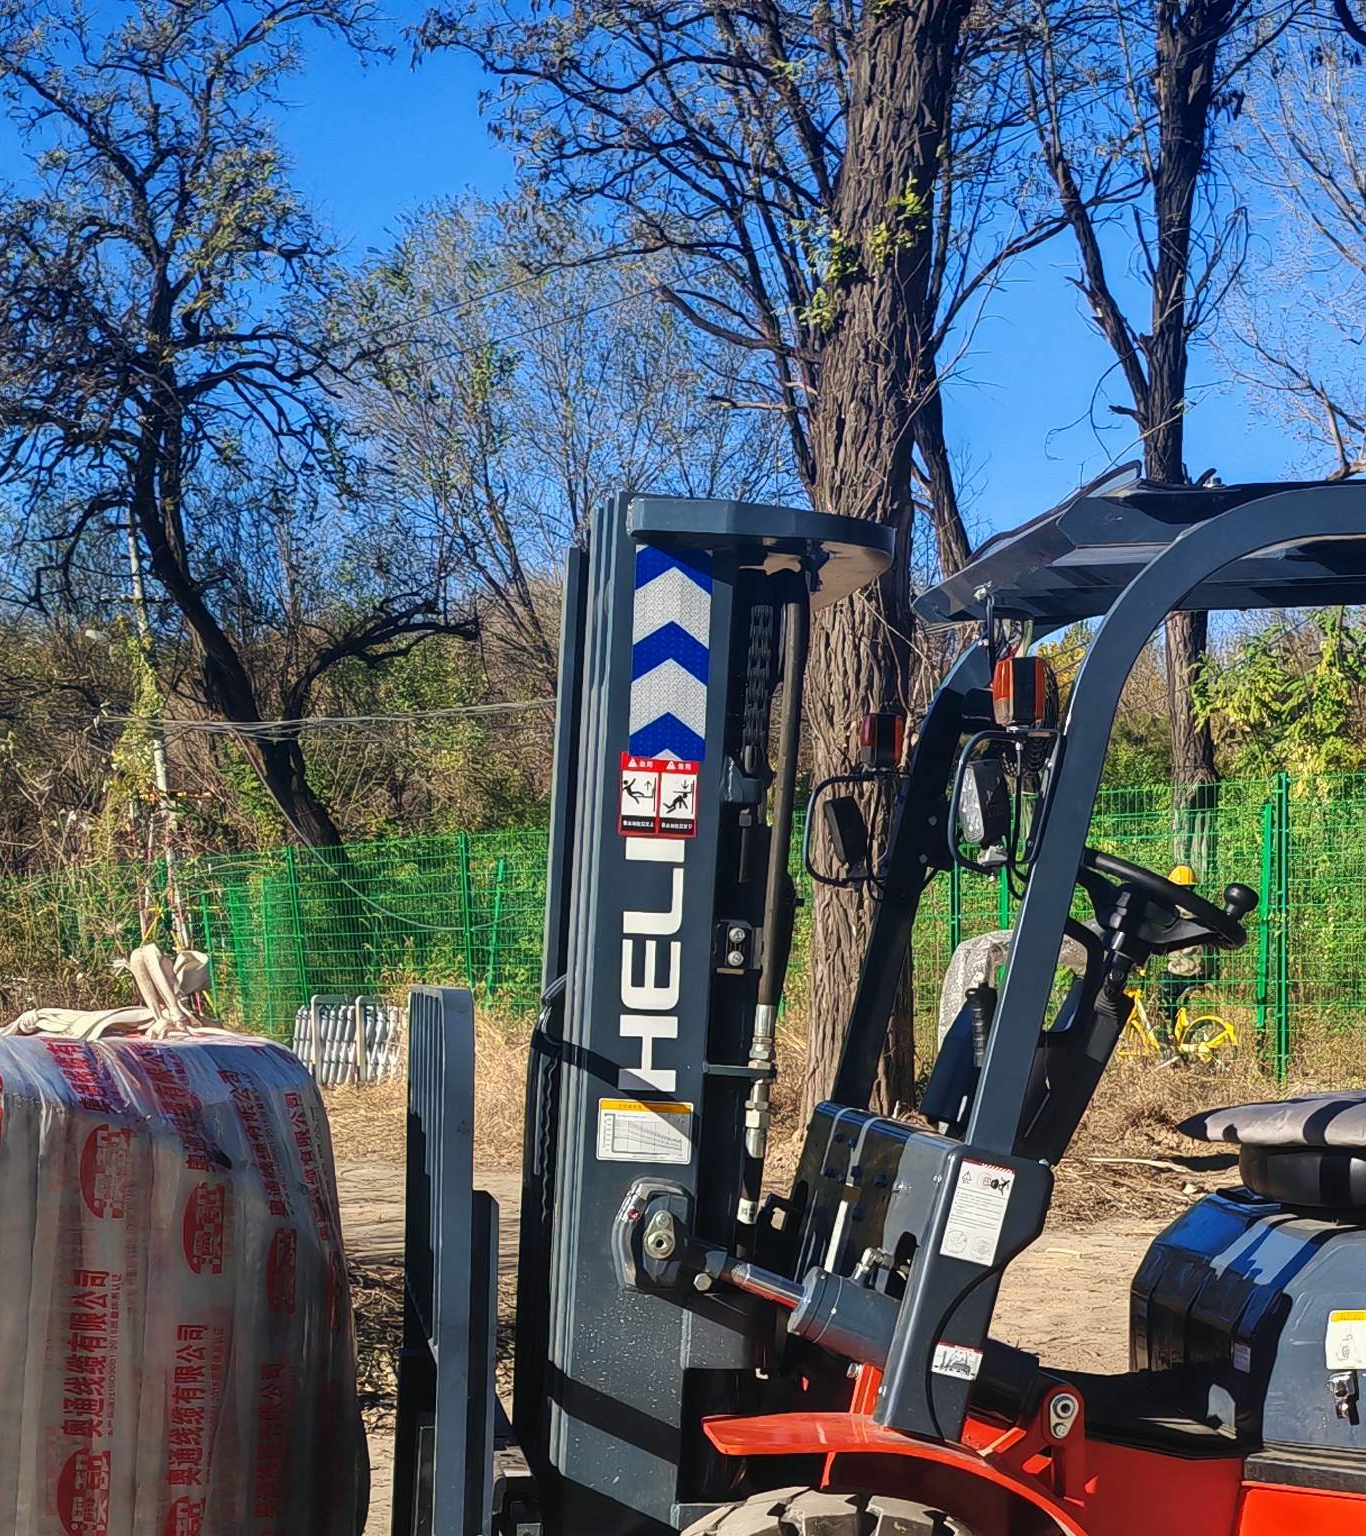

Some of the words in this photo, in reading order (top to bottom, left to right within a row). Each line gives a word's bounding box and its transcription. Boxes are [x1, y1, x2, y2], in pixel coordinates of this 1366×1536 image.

[618, 837, 685, 1092] HELI
[61, 1269, 110, 1439] 奥通线缆有限公司
[165, 1324, 208, 1487] 奥通线缆有限公司
